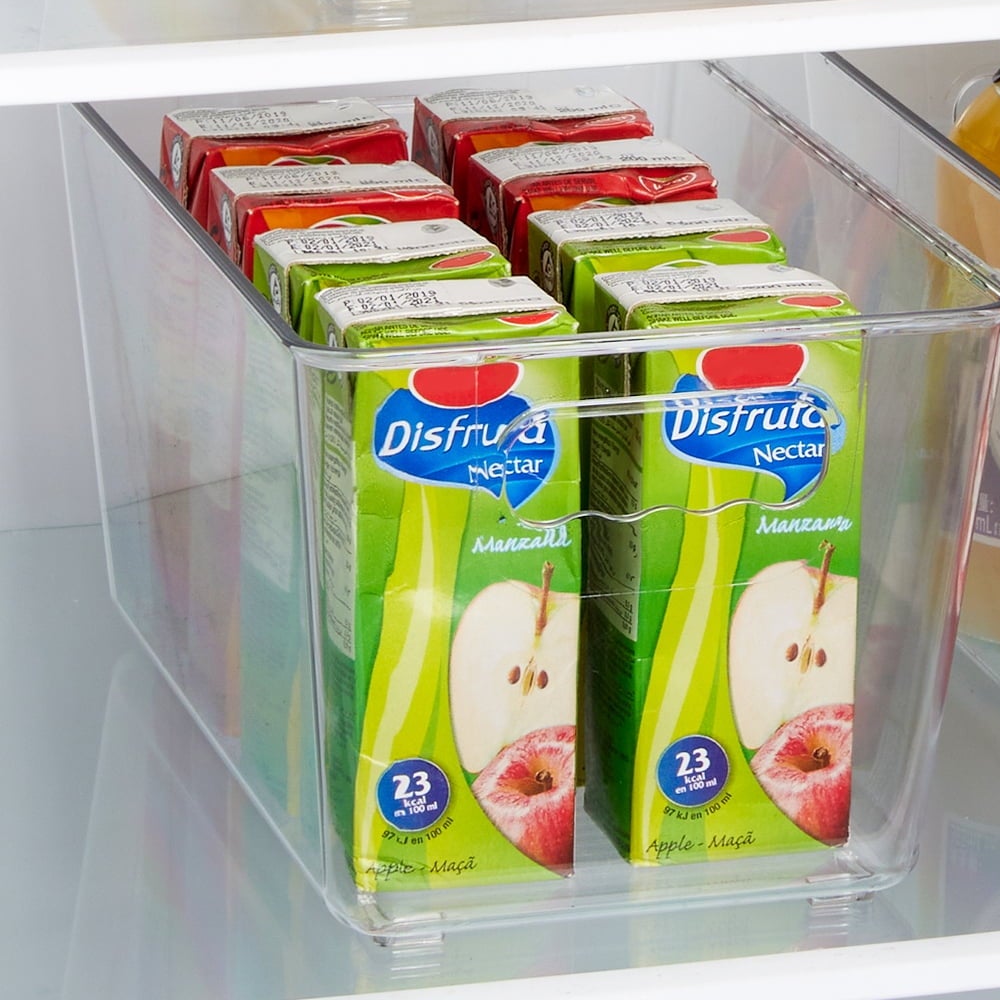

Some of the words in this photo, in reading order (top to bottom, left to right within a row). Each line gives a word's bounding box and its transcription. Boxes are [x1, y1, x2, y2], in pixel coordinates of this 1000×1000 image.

[378, 408, 550, 458] Disfrua
[675, 747, 711, 777] 23
[392, 771, 432, 800] 23
[674, 786, 687, 795] en
[689, 780, 705, 792] 100
[705, 777, 718, 788] ml
[683, 771, 706, 785] kcal
[403, 795, 427, 808] kcal
[408, 804, 426, 815] 100
[426, 801, 438, 812] ml
[663, 805, 676, 817] 97
[690, 811, 702, 820] en
[704, 802, 721, 816] 100
[381, 830, 396, 840] 97
[425, 827, 442, 841] 100
[645, 834, 695, 860] Apple
[707, 830, 756, 850] Maçã
[429, 856, 478, 876] Maçã
